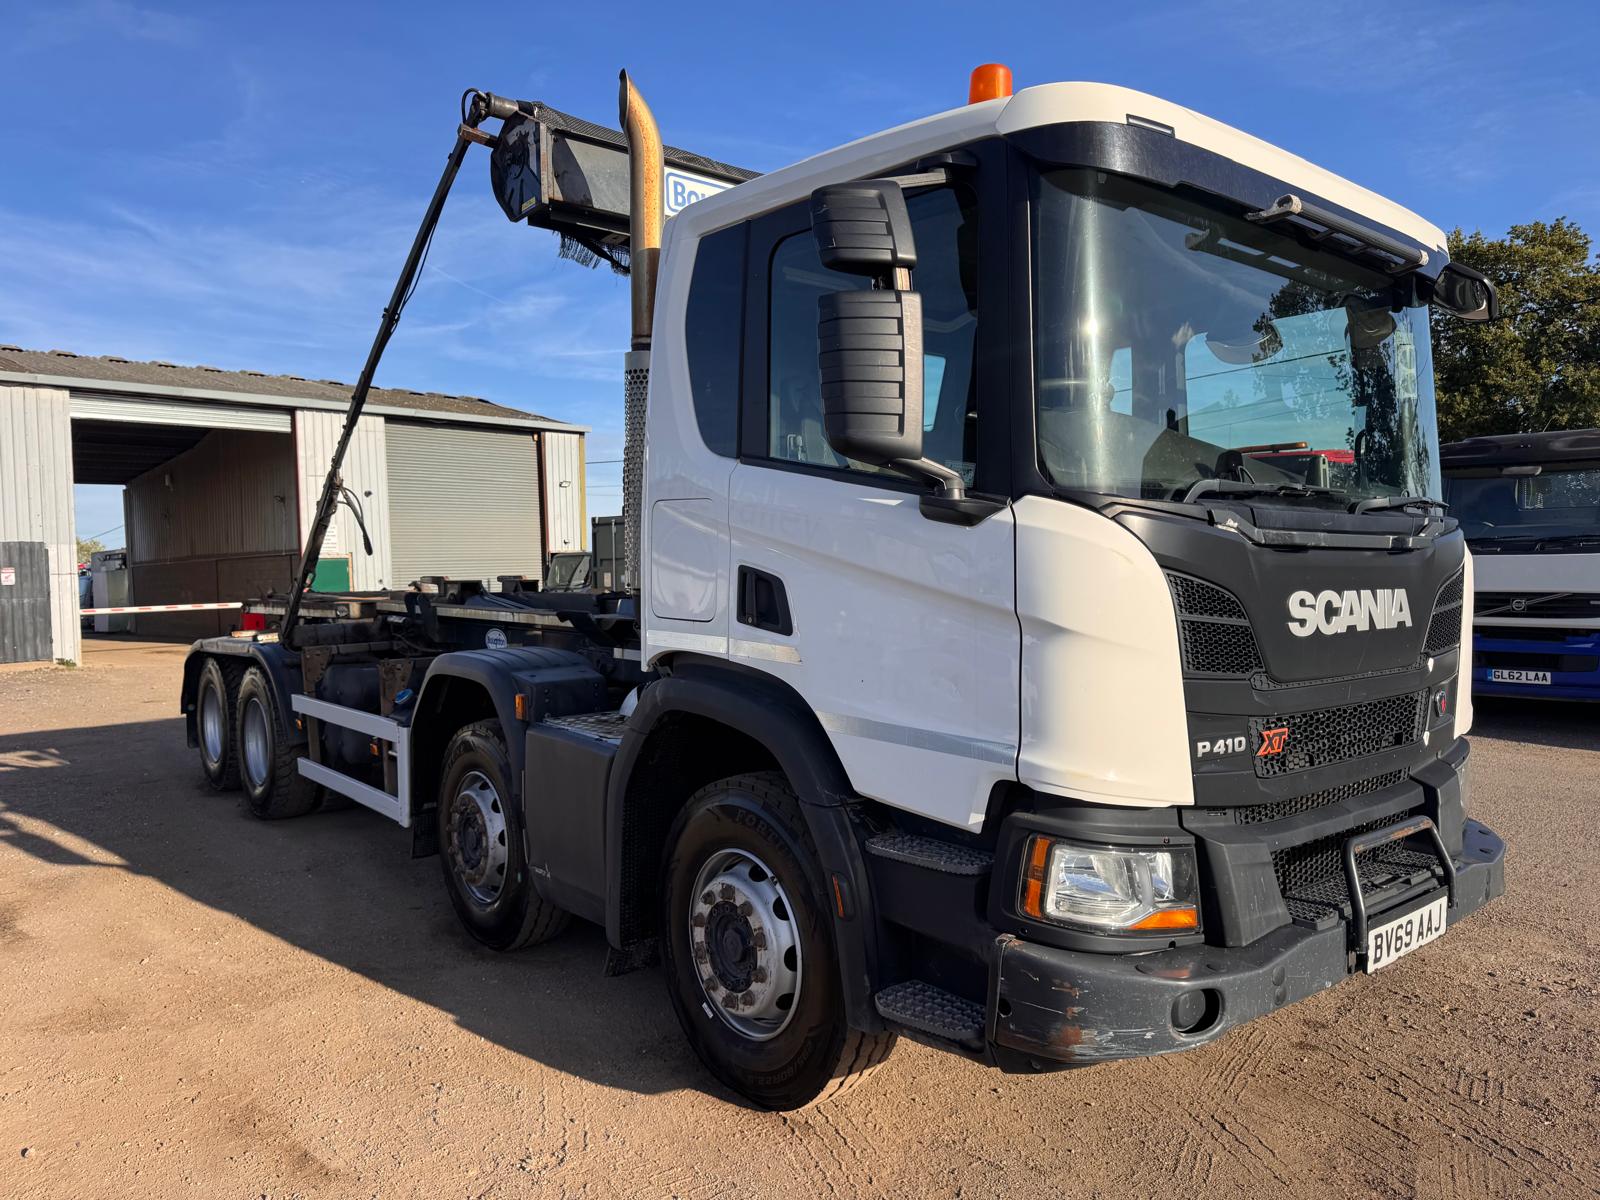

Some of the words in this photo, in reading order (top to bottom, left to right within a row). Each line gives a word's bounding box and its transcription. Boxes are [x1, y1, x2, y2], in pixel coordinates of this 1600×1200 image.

[673, 181, 710, 207] Bo
[1287, 588, 1413, 637] SCANIA
[1493, 670, 1523, 681] GL62
[1526, 672, 1548, 682] LAA
[1256, 728, 1289, 756] XT
[1373, 918, 1413, 965] BV69
[1416, 904, 1442, 943] AAJ
